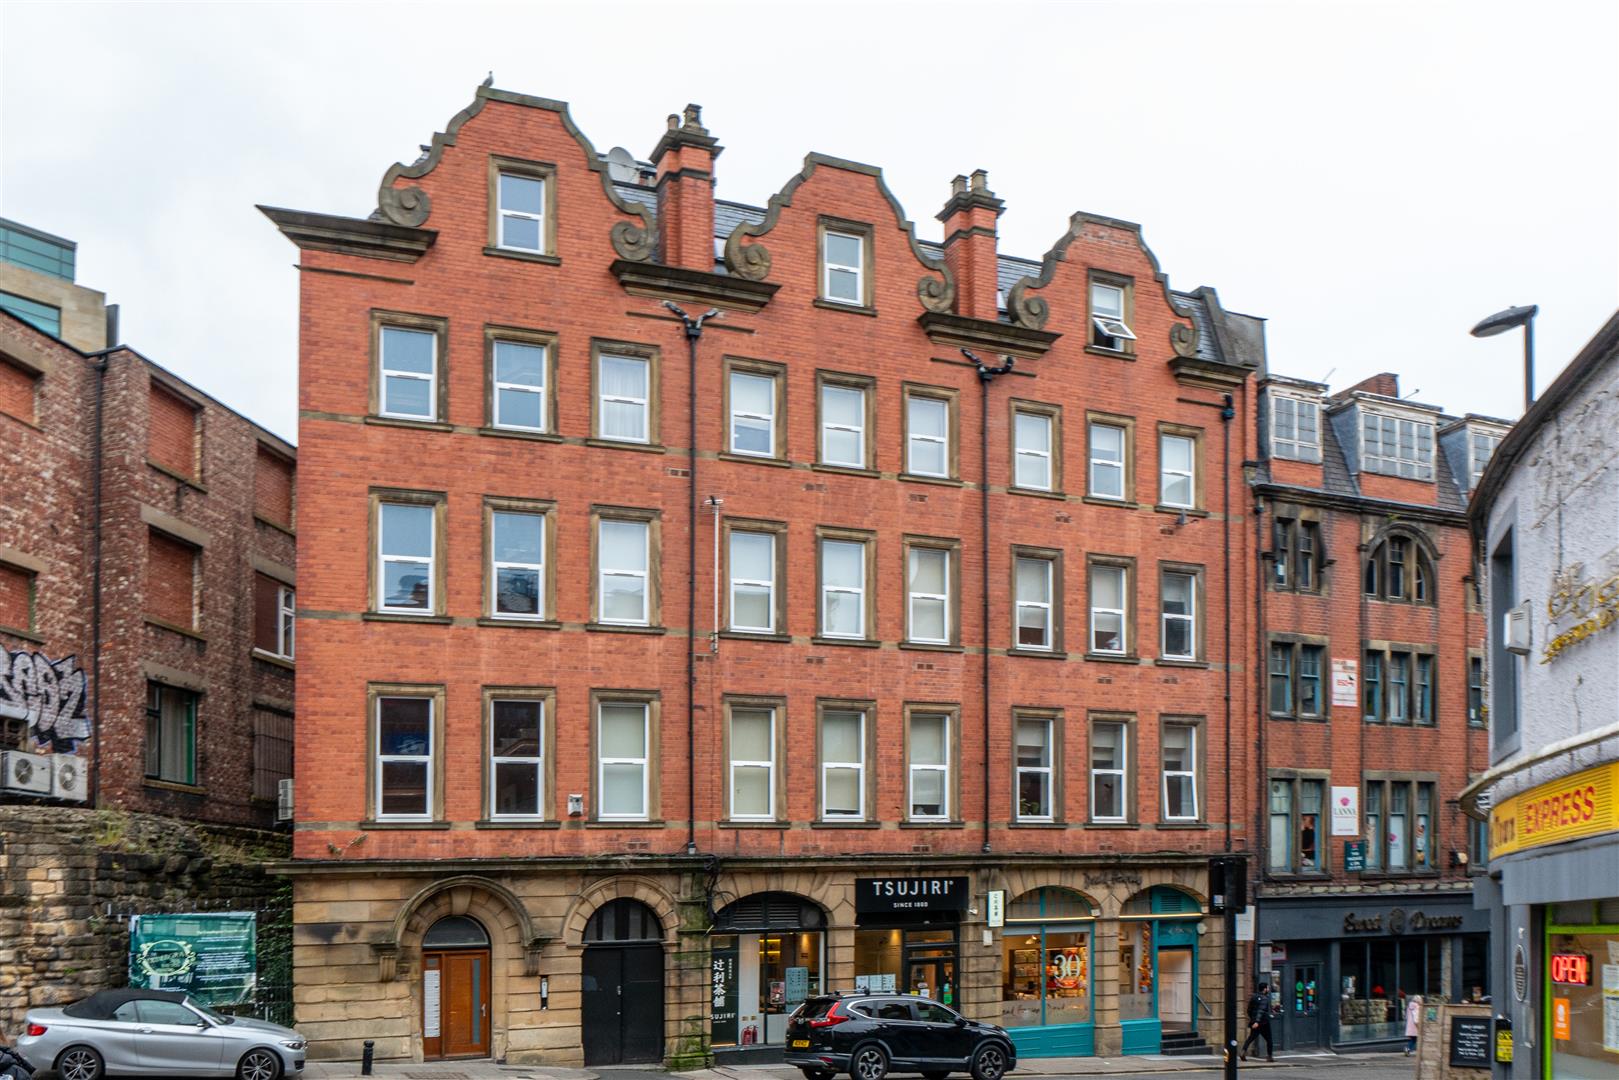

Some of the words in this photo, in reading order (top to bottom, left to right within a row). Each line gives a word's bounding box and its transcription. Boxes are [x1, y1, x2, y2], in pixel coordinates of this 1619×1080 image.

[1525, 785, 1596, 833] EXPRESS
[872, 880, 949, 896] TSUJIRI
[1054, 954, 1081, 979] 30
[1552, 955, 1587, 983] OPEN
